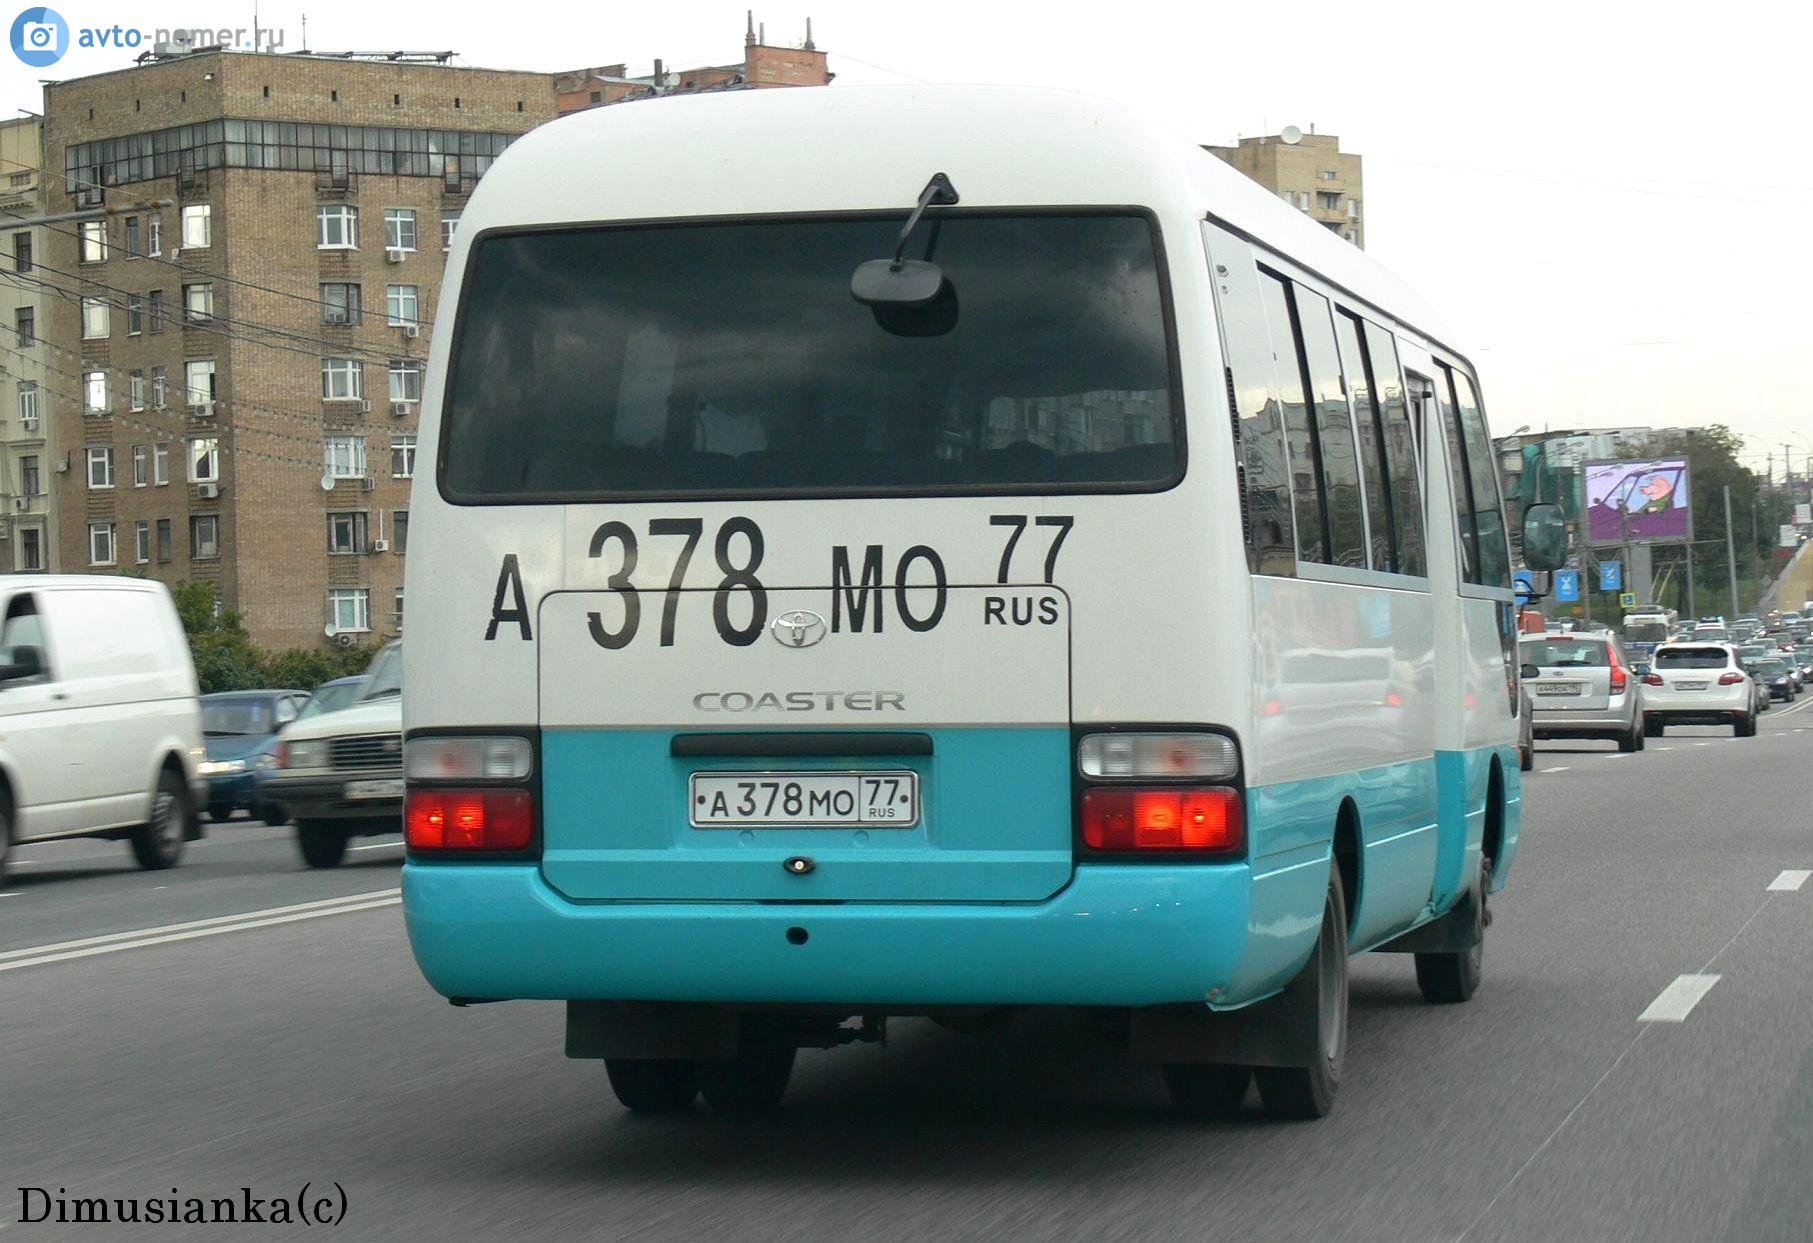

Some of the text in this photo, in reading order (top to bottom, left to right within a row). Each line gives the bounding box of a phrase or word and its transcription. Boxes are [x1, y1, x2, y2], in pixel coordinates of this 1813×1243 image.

[989, 514, 1075, 585] 77
[484, 516, 947, 650] A 378 MO
[983, 596, 1059, 626] RUS
[693, 691, 906, 712] COASTER
[865, 779, 900, 806] 77
[868, 807, 896, 818] RUS
